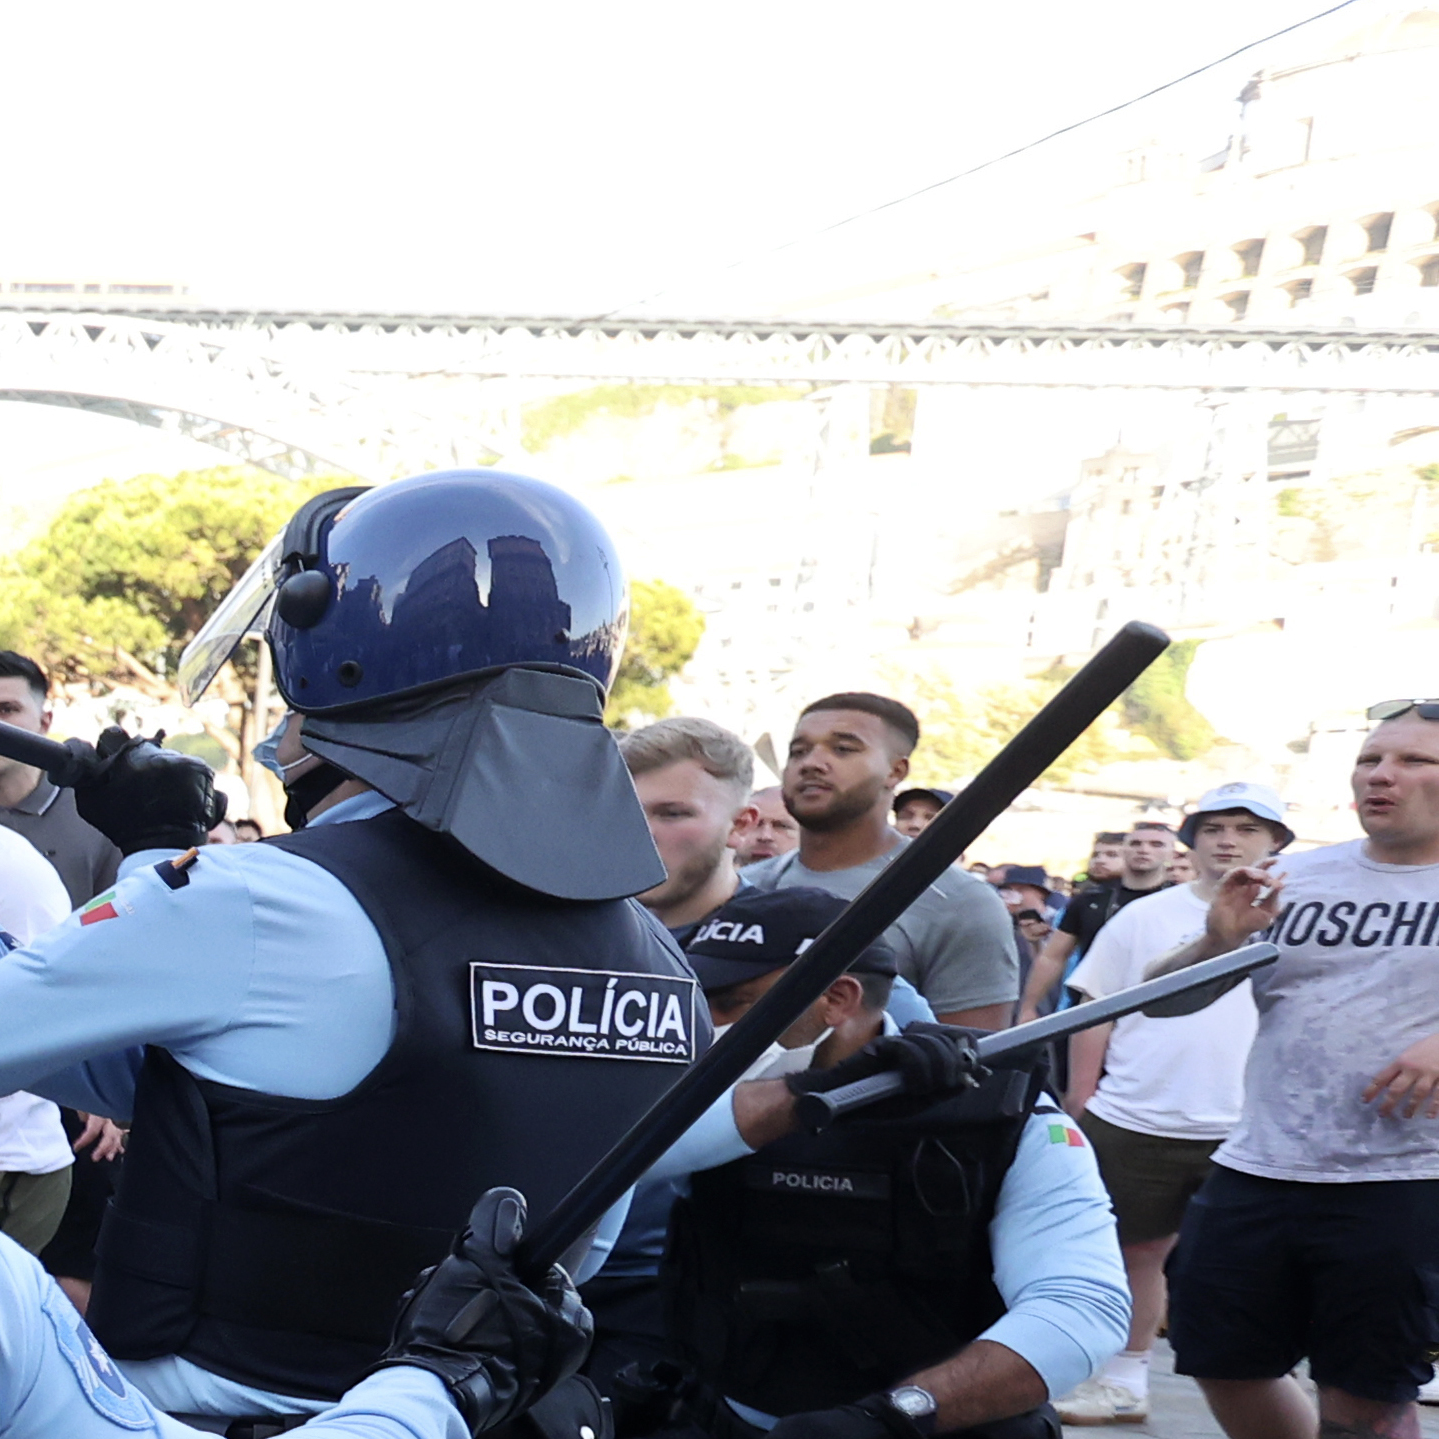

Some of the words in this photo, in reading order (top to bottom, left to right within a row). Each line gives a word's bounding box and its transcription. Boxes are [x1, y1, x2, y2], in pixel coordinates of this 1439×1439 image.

[482, 978, 687, 1041] POLÍCIA
[484, 1030, 610, 1052] SEGURANÇA
[615, 1037, 688, 1056] PÚBLICA
[772, 1172, 853, 1191] POLICIA
